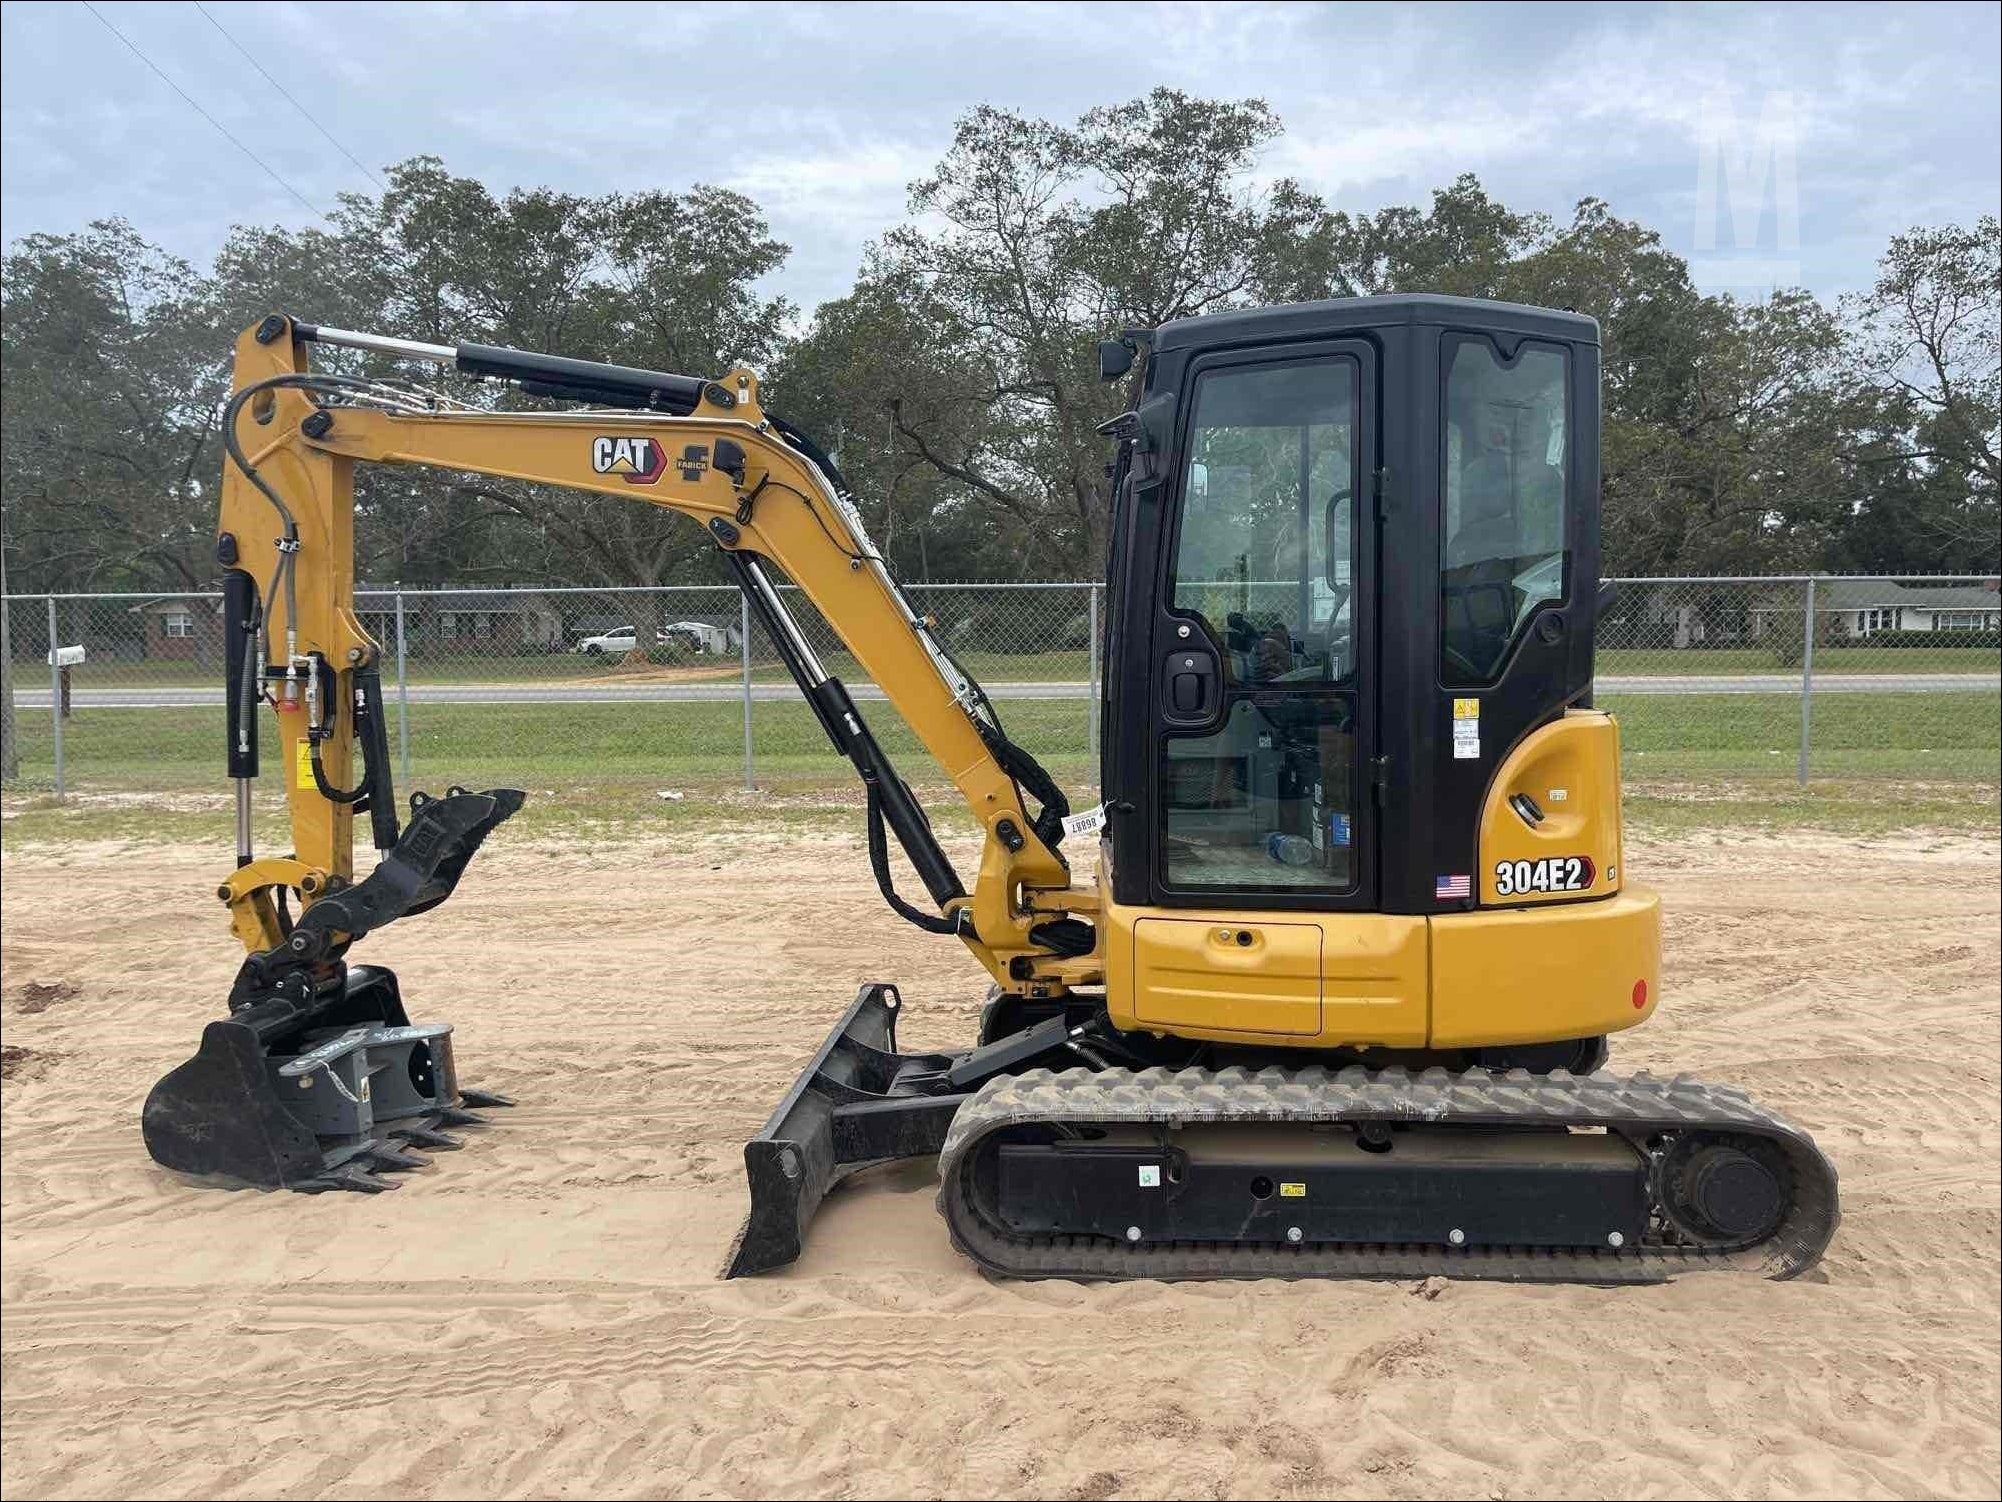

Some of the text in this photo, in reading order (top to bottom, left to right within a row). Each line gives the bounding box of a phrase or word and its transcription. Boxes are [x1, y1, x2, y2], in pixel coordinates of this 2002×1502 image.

[594, 438, 649, 473] CAT
[1072, 818, 1096, 833] 86887
[1496, 858, 1582, 894] 304E2
